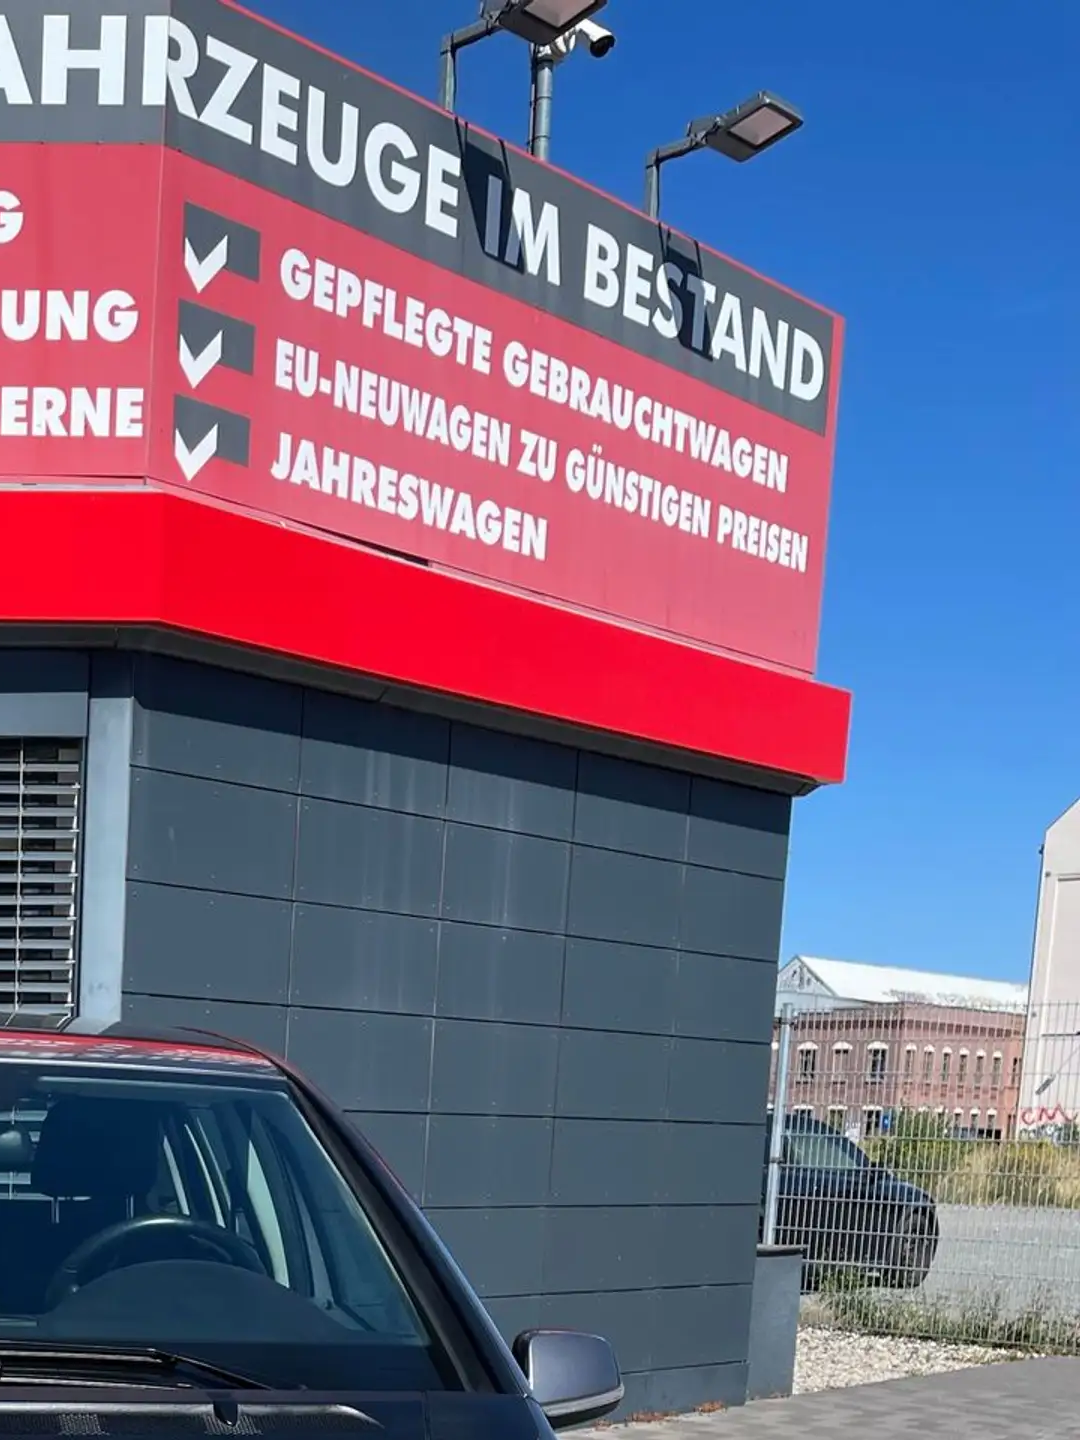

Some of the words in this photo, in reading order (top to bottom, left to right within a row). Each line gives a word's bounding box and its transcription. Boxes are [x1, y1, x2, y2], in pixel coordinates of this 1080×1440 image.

[280, 248, 492, 375] GEPFLEGTE
[502, 343, 789, 493] GEBRAUCHTWAGEN
[484, 175, 562, 286] IM
[583, 223, 825, 402] BESTAND
[270, 434, 548, 560] JAHRESWAGEN
[274, 338, 511, 467] EU-NEUWAGEN
[518, 427, 556, 482] ZU
[565, 442, 711, 540] GÜNSTIGEN
[717, 505, 809, 573] PREISEN
